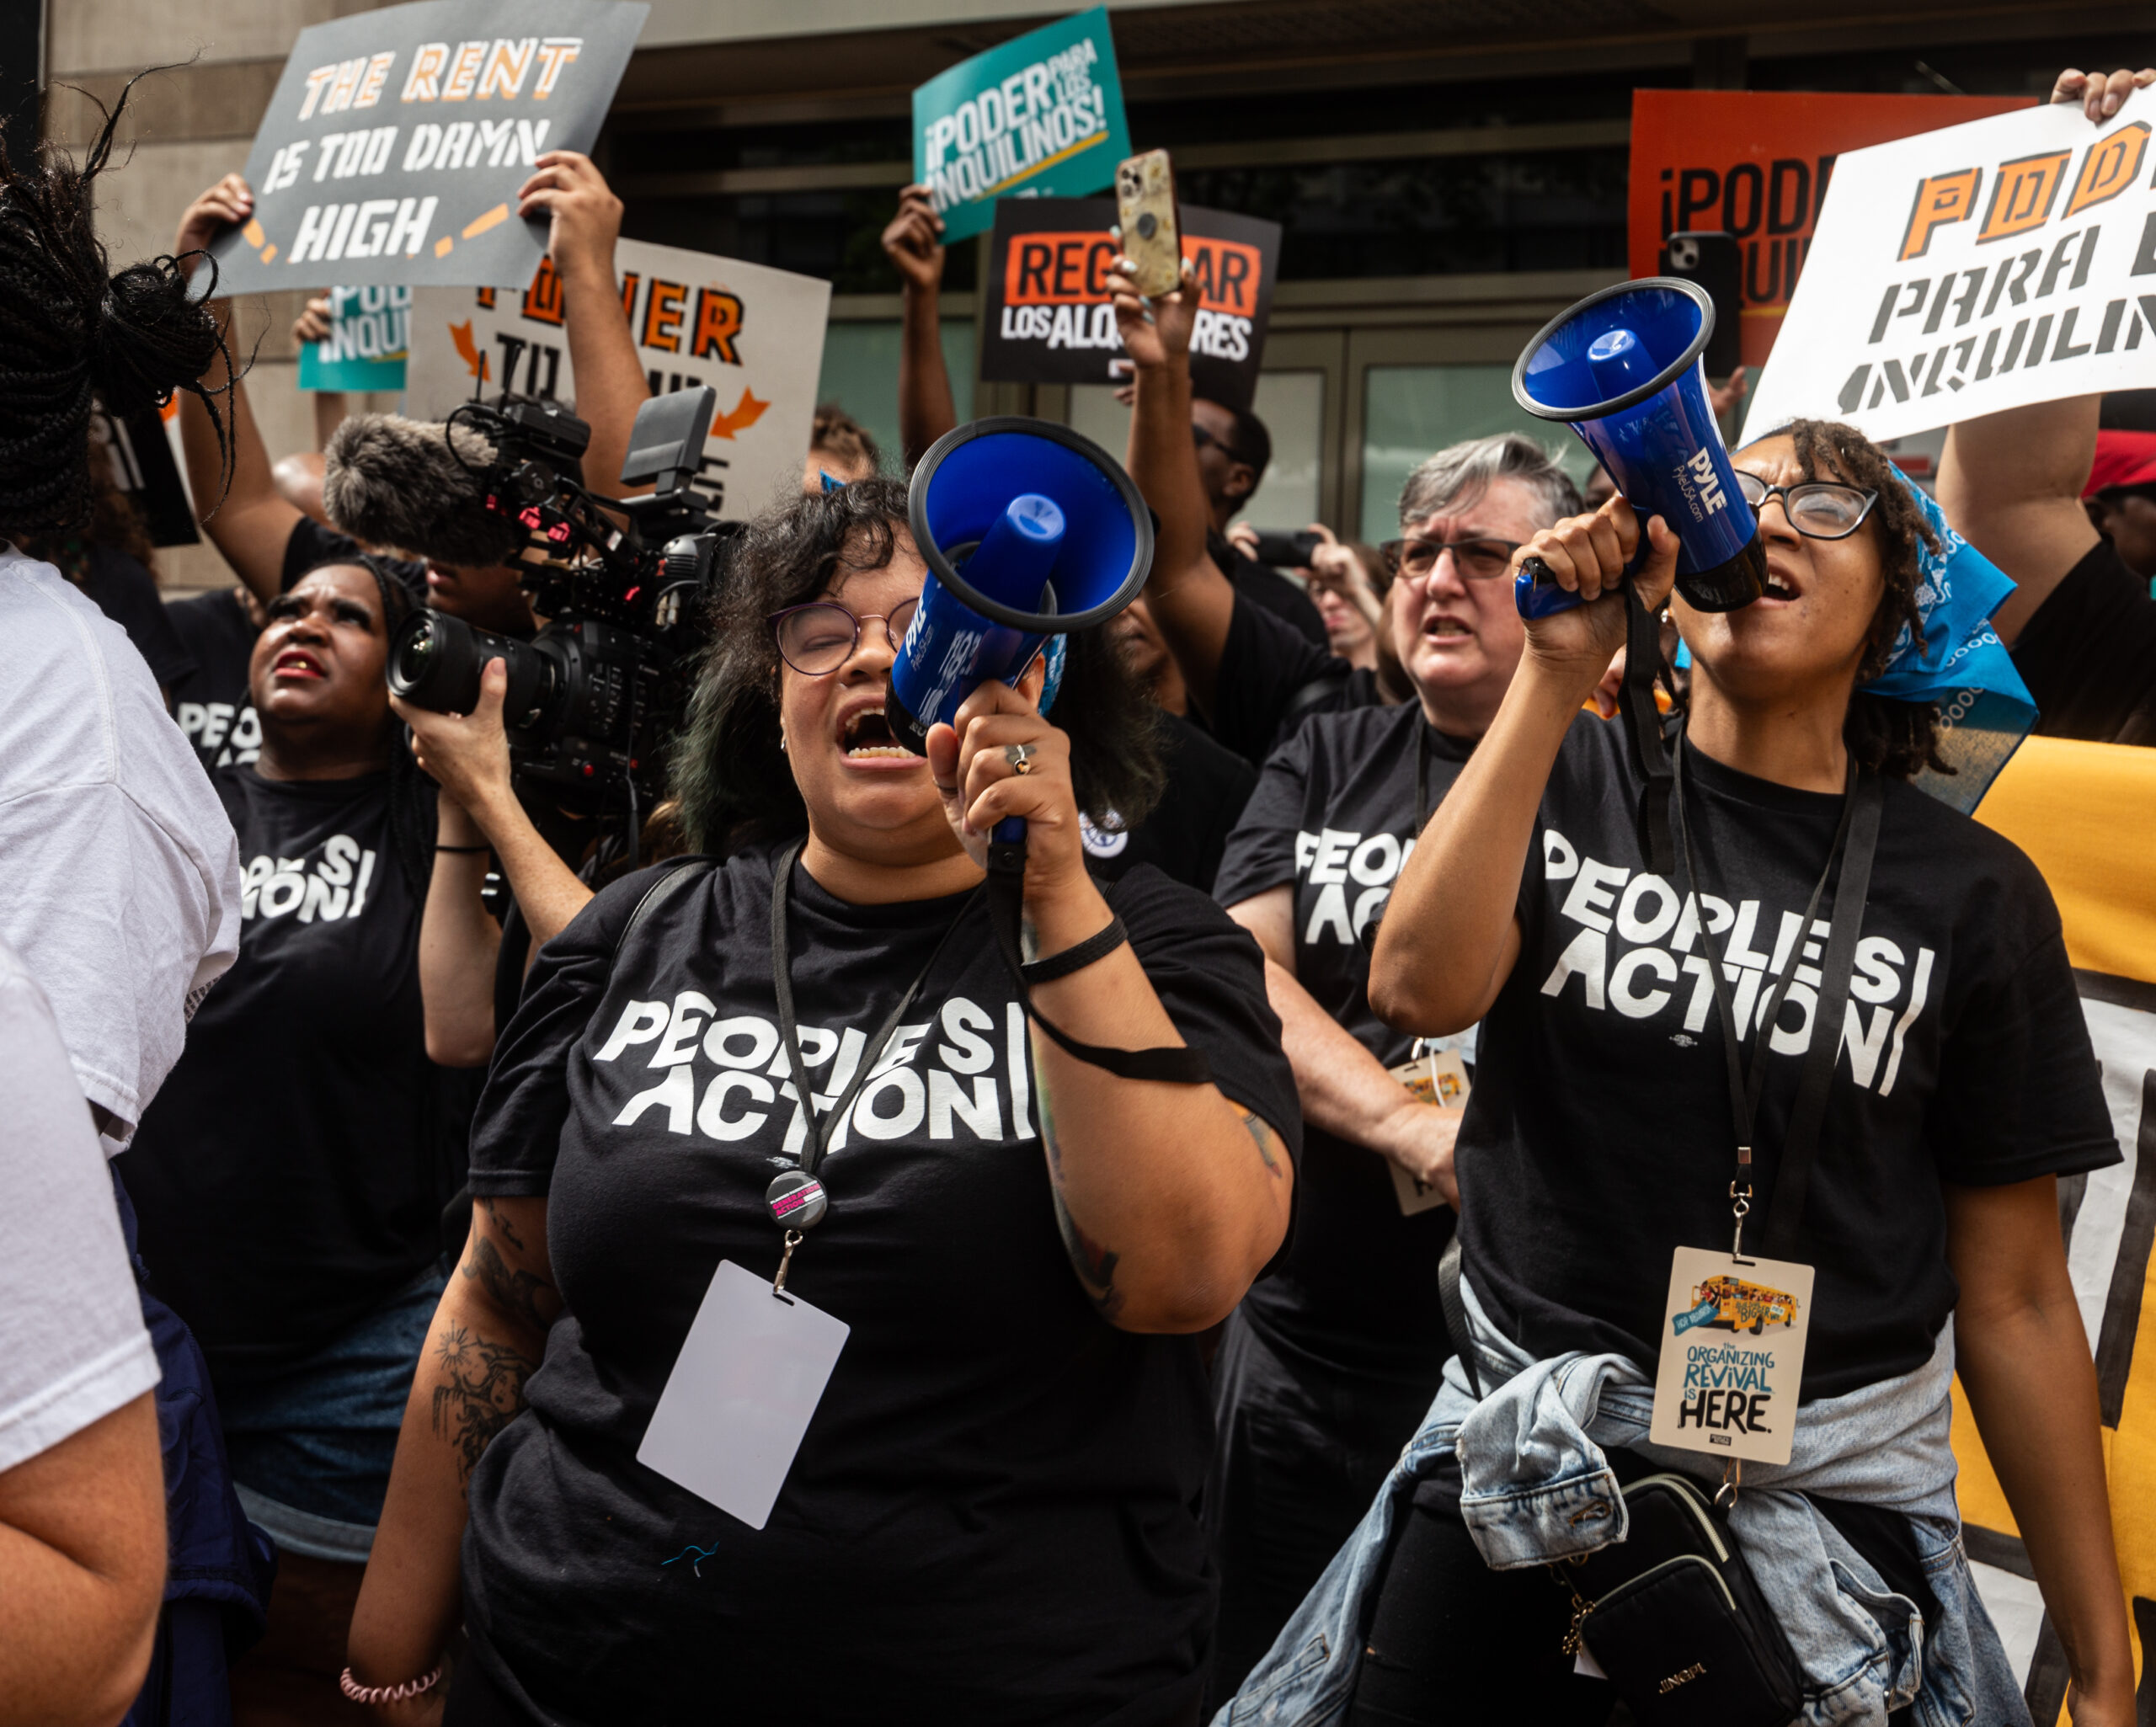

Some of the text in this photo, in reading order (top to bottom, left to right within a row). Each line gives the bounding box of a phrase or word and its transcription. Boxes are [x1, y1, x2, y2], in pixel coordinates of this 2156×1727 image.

[298, 37, 584, 120] THE RENT
[1049, 37, 1097, 80] PARA
[1055, 67, 1092, 103] LOS
[262, 119, 551, 195] IS TOO DAMN
[1897, 120, 2156, 262] POD
[288, 196, 439, 264] HIGH
[1017, 242, 1250, 309] REGAR
[1868, 225, 2100, 344] PARA
[1672, 465, 1704, 523] PyleUSA.com
[1687, 446, 1727, 515] PYLE
[905, 591, 926, 658] PYLE
[1540, 927, 1893, 1088] ACTION
[611, 1064, 1003, 1155] ACTION
[772, 1183, 821, 1210] GENERATION
[776, 1198, 805, 1217] ACTION
[1687, 1346, 1774, 1368] ORGANIZING
[1678, 1389, 1772, 1435] HERE.
